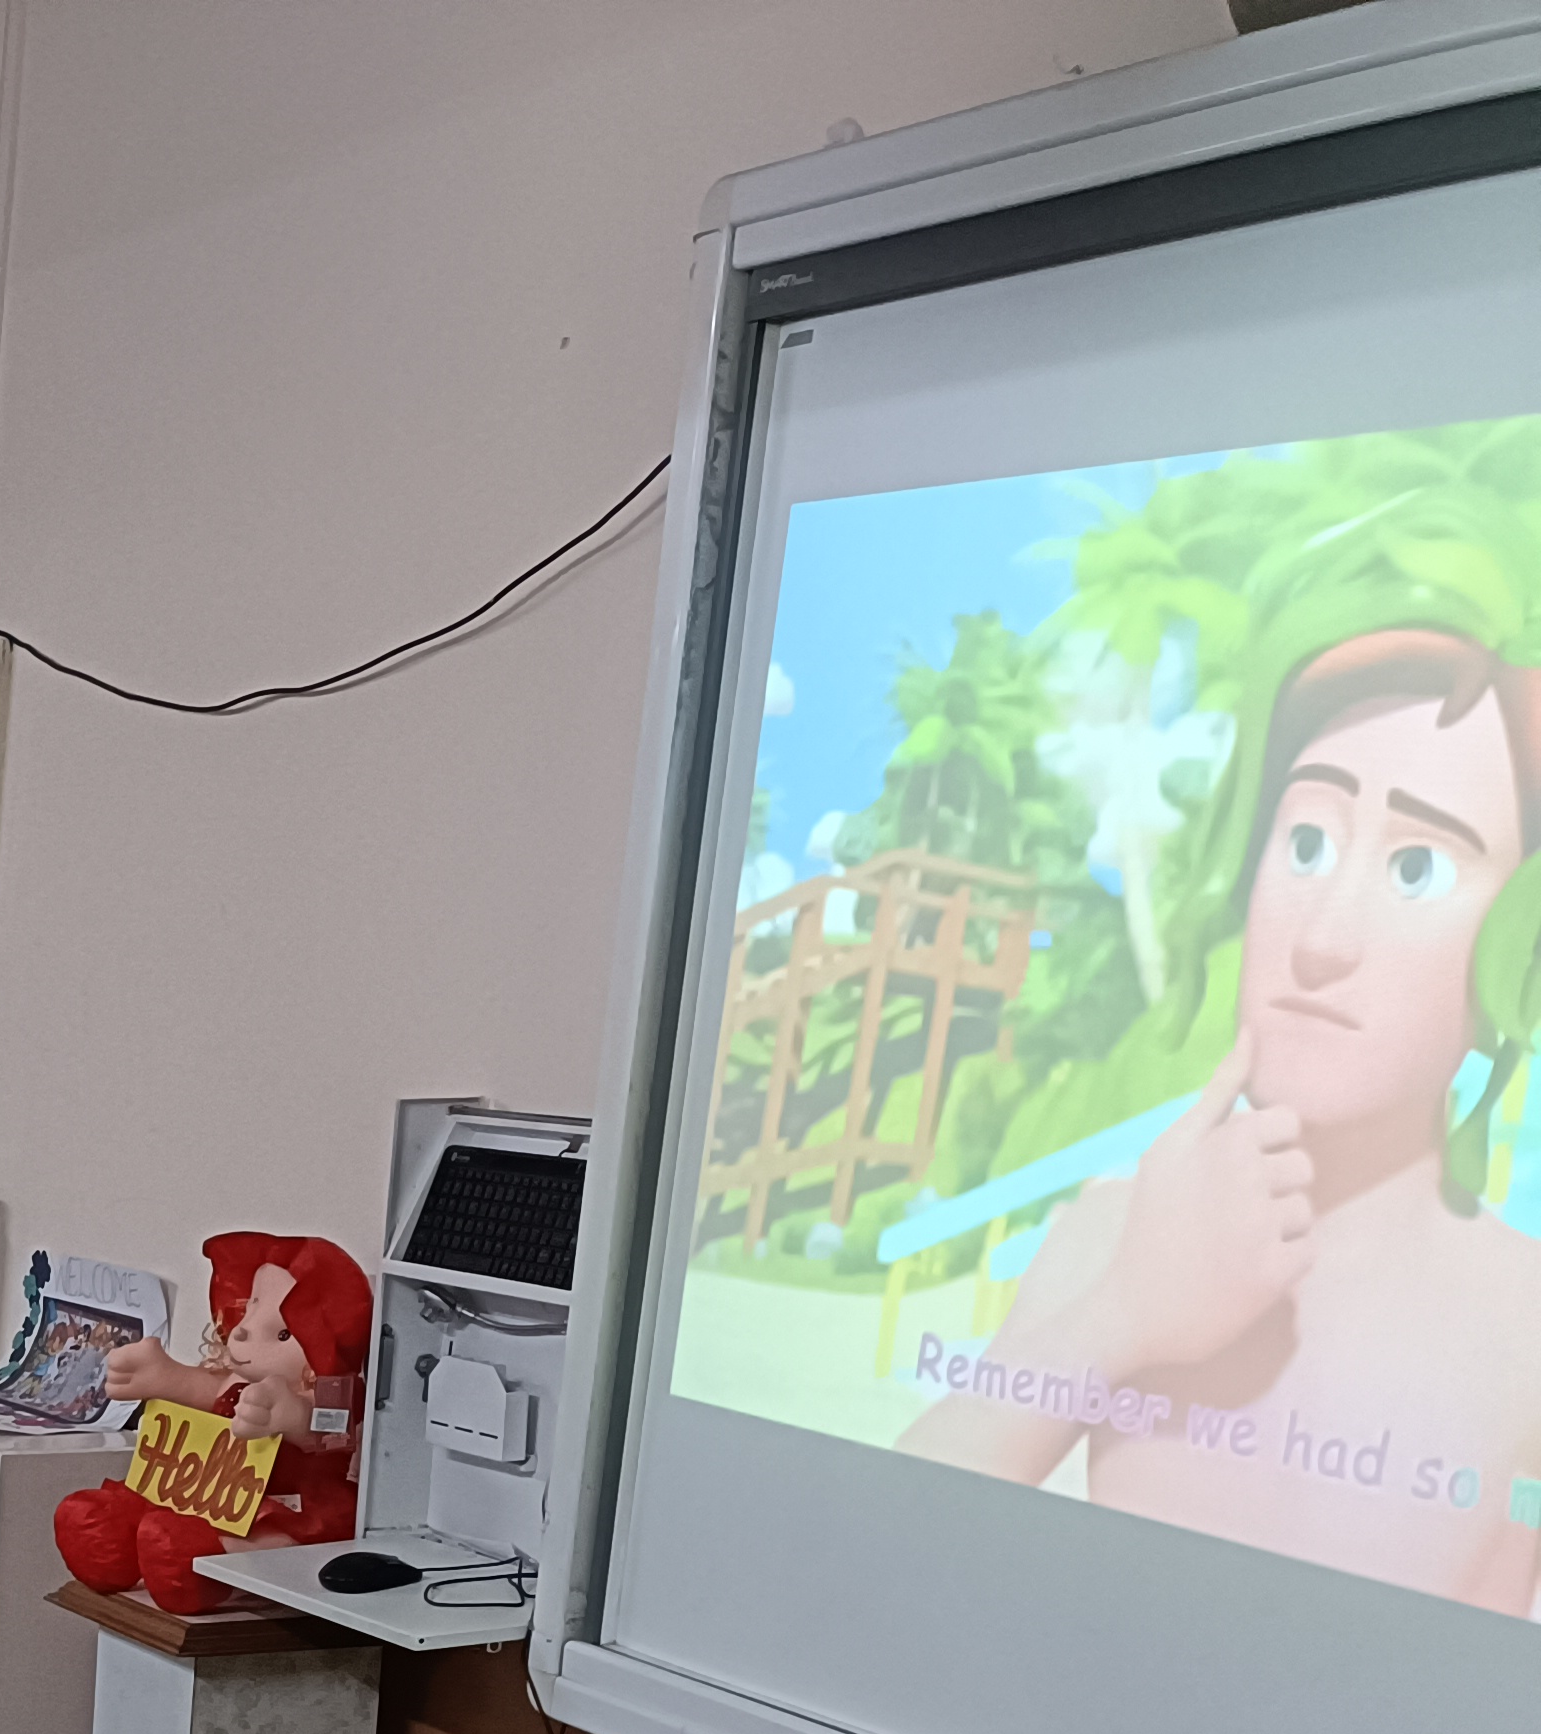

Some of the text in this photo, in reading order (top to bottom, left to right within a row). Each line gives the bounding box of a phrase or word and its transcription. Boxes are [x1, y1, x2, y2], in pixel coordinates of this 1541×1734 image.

[136, 1413, 265, 1523] Hello
[916, 1331, 1171, 1437] Remember
[1187, 1403, 1259, 1458] we
[1282, 1408, 1391, 1488] had
[1410, 1457, 1481, 1510] so
